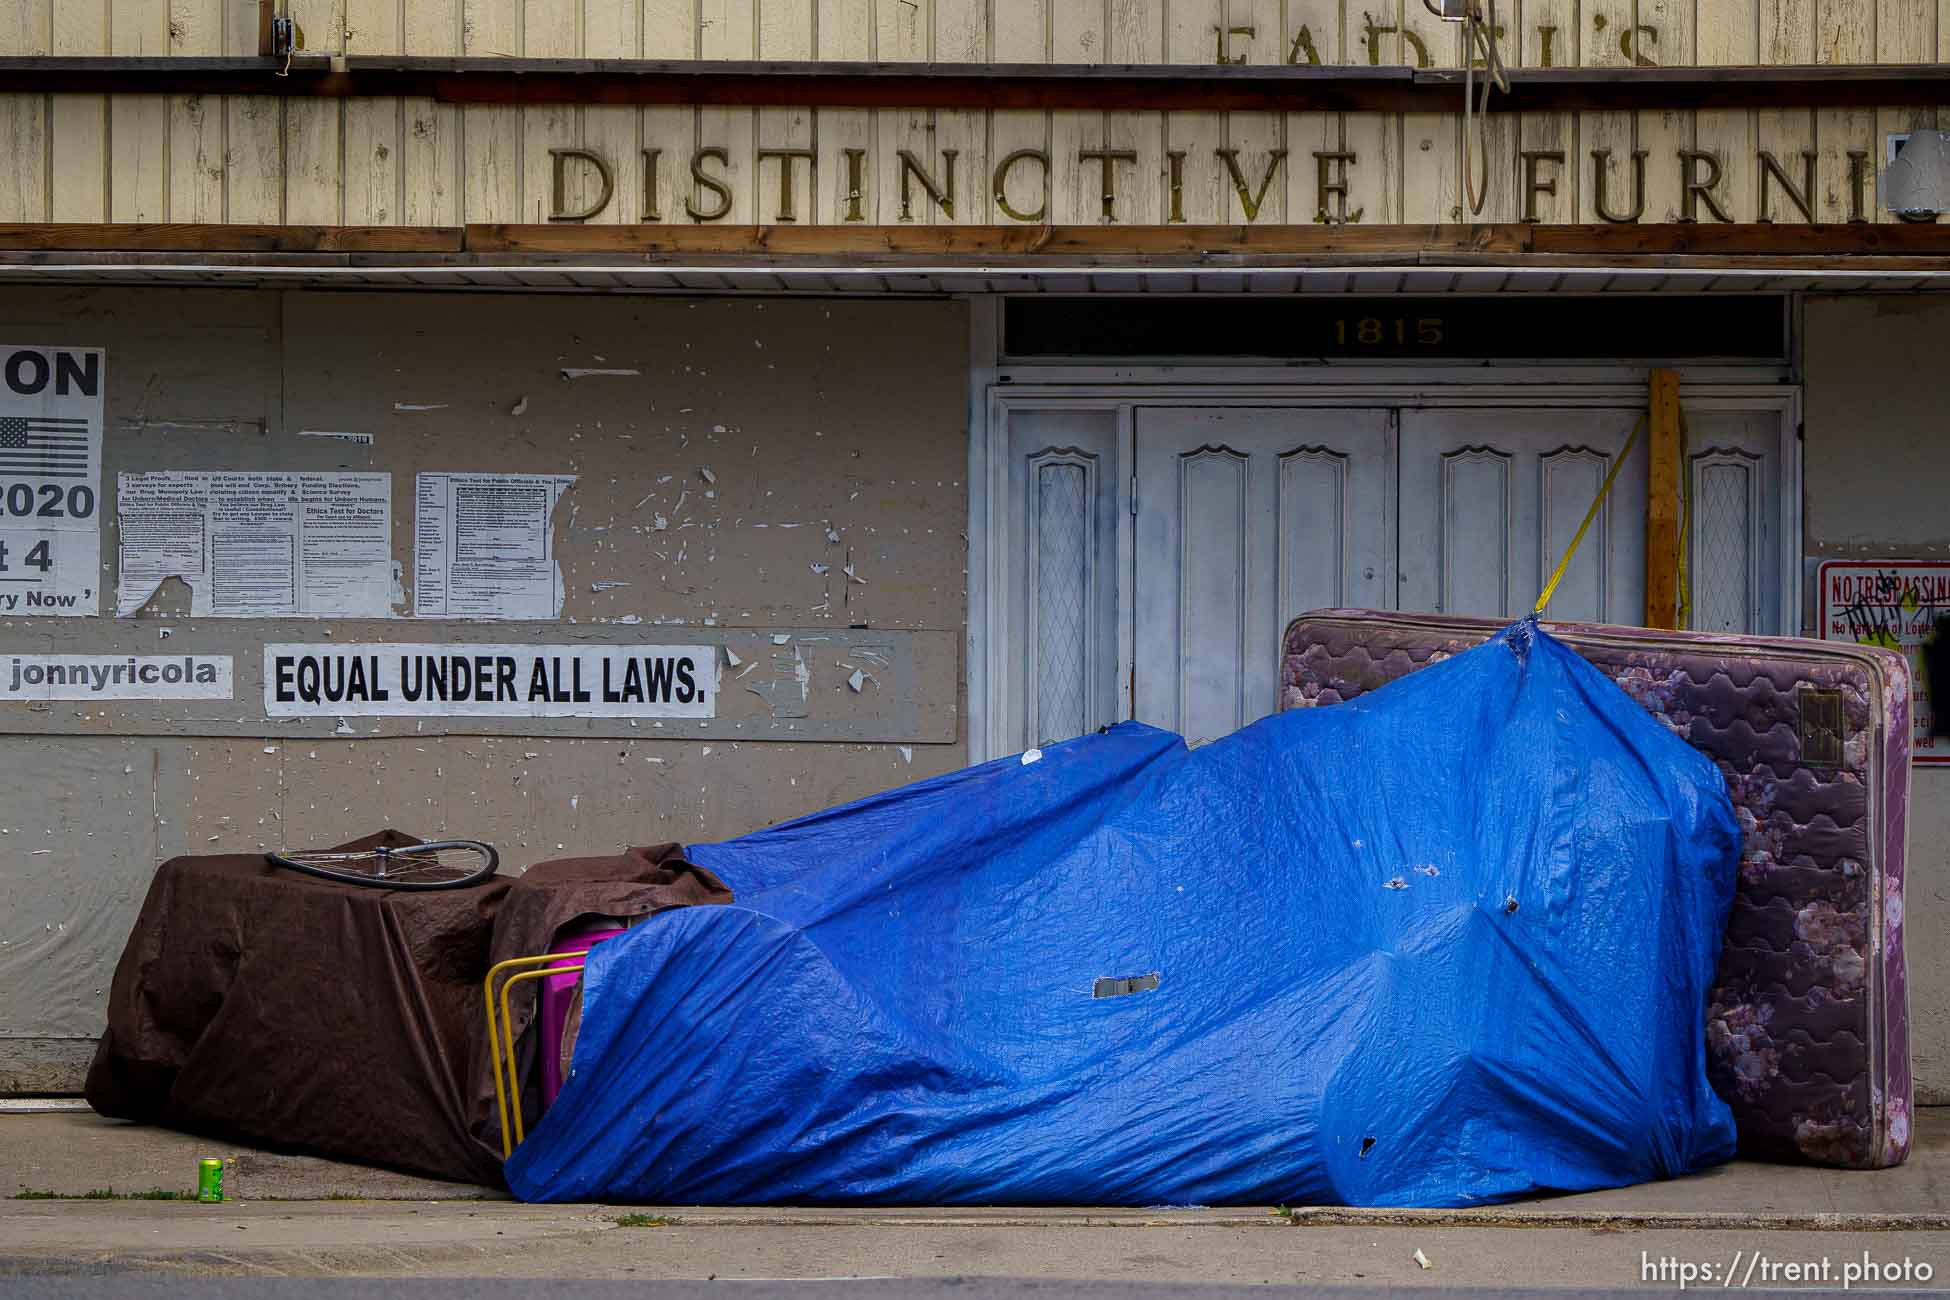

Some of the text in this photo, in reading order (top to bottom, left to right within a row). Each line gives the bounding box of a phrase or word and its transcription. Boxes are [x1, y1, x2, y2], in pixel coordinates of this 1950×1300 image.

[552, 147, 1363, 225] DISTINCTIVE
[1336, 317, 1443, 345] 1815
[0, 484, 95, 519] 020
[306, 507, 384, 515] Ethics Test for Doctors
[24, 540, 53, 572] 4
[1832, 576, 1852, 603] NO
[8, 658, 218, 691] jonnyricola
[275, 655, 705, 706] EQUAL UNDER ALL LAWS.
